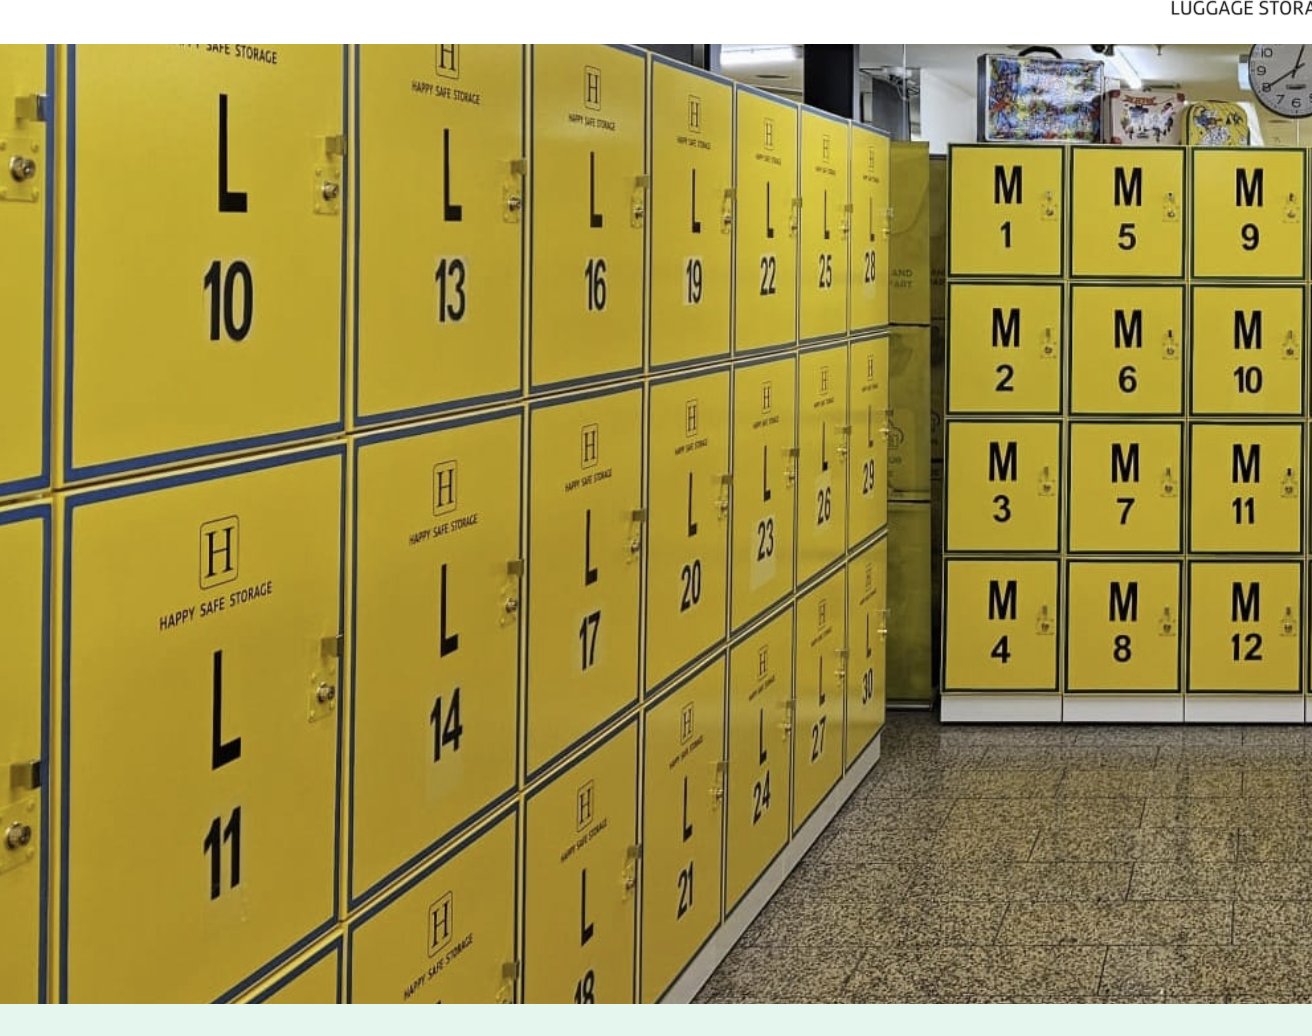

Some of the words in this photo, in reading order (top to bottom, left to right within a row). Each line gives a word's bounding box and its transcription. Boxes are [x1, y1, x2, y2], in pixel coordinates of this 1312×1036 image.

[235, 44, 277, 65] STORAGE
[1257, 65, 1267, 76] 9
[1261, 47, 1273, 58] 10
[587, 72, 599, 104] H
[1276, 94, 1285, 105] 7
[1292, 98, 1301, 108] 6
[219, 94, 247, 212] L
[444, 129, 462, 221] L
[590, 152, 602, 227] L
[995, 166, 1022, 203] M
[1115, 167, 1141, 206] M
[1237, 169, 1263, 206] M
[692, 170, 700, 233] L
[767, 182, 773, 238] L
[824, 191, 829, 239] L
[870, 197, 875, 242] L
[1001, 222, 1010, 247] 1
[1119, 224, 1136, 250] 5
[1242, 224, 1259, 250] 9
[585, 260, 605, 310] 16
[687, 260, 702, 303] 19
[760, 257, 775, 295] 22
[819, 254, 831, 287] 25
[204, 261, 253, 341] 10
[436, 259, 465, 322] 13
[993, 308, 1019, 347] M
[1115, 310, 1141, 348] M
[1235, 311, 1261, 349] M
[996, 365, 1013, 391] 2
[1119, 366, 1136, 393] 6
[1234, 367, 1262, 393] 10
[584, 430, 596, 462] H
[822, 422, 828, 471] L
[869, 409, 873, 448] L
[764, 446, 770, 501] L
[863, 460, 874, 494] 29
[989, 442, 1016, 481] M
[1112, 443, 1138, 482] M
[1233, 444, 1259, 483] M
[437, 468, 454, 507] H
[688, 473, 697, 537] L
[818, 487, 830, 525] 26
[994, 495, 1010, 522] 3
[1117, 498, 1134, 524] 7
[1233, 498, 1254, 524] 11
[205, 526, 235, 579] H
[586, 510, 597, 585] L
[758, 519, 773, 561] 23
[681, 560, 700, 611] 20
[989, 581, 1016, 619] M
[1110, 582, 1137, 621] M
[1232, 582, 1259, 621] M
[159, 606, 195, 631] HAPPY
[200, 597, 225, 617] SAFE
[230, 581, 273, 607] STORAGE
[441, 564, 458, 657] L
[580, 611, 600, 670] 17
[866, 615, 871, 658] L
[991, 636, 1010, 663] 4
[1114, 635, 1131, 662] 8
[1232, 634, 1262, 660] 12
[819, 657, 825, 706] L
[863, 668, 872, 704] 30
[212, 650, 241, 769] L
[431, 688, 462, 762] 14
[760, 710, 767, 765] L
[812, 716, 826, 761] 27
[683, 777, 692, 841] L
[754, 771, 770, 824] 24
[204, 806, 240, 900] 11
[581, 869, 593, 945] L
[678, 862, 693, 919] 21
[432, 900, 450, 948] H
